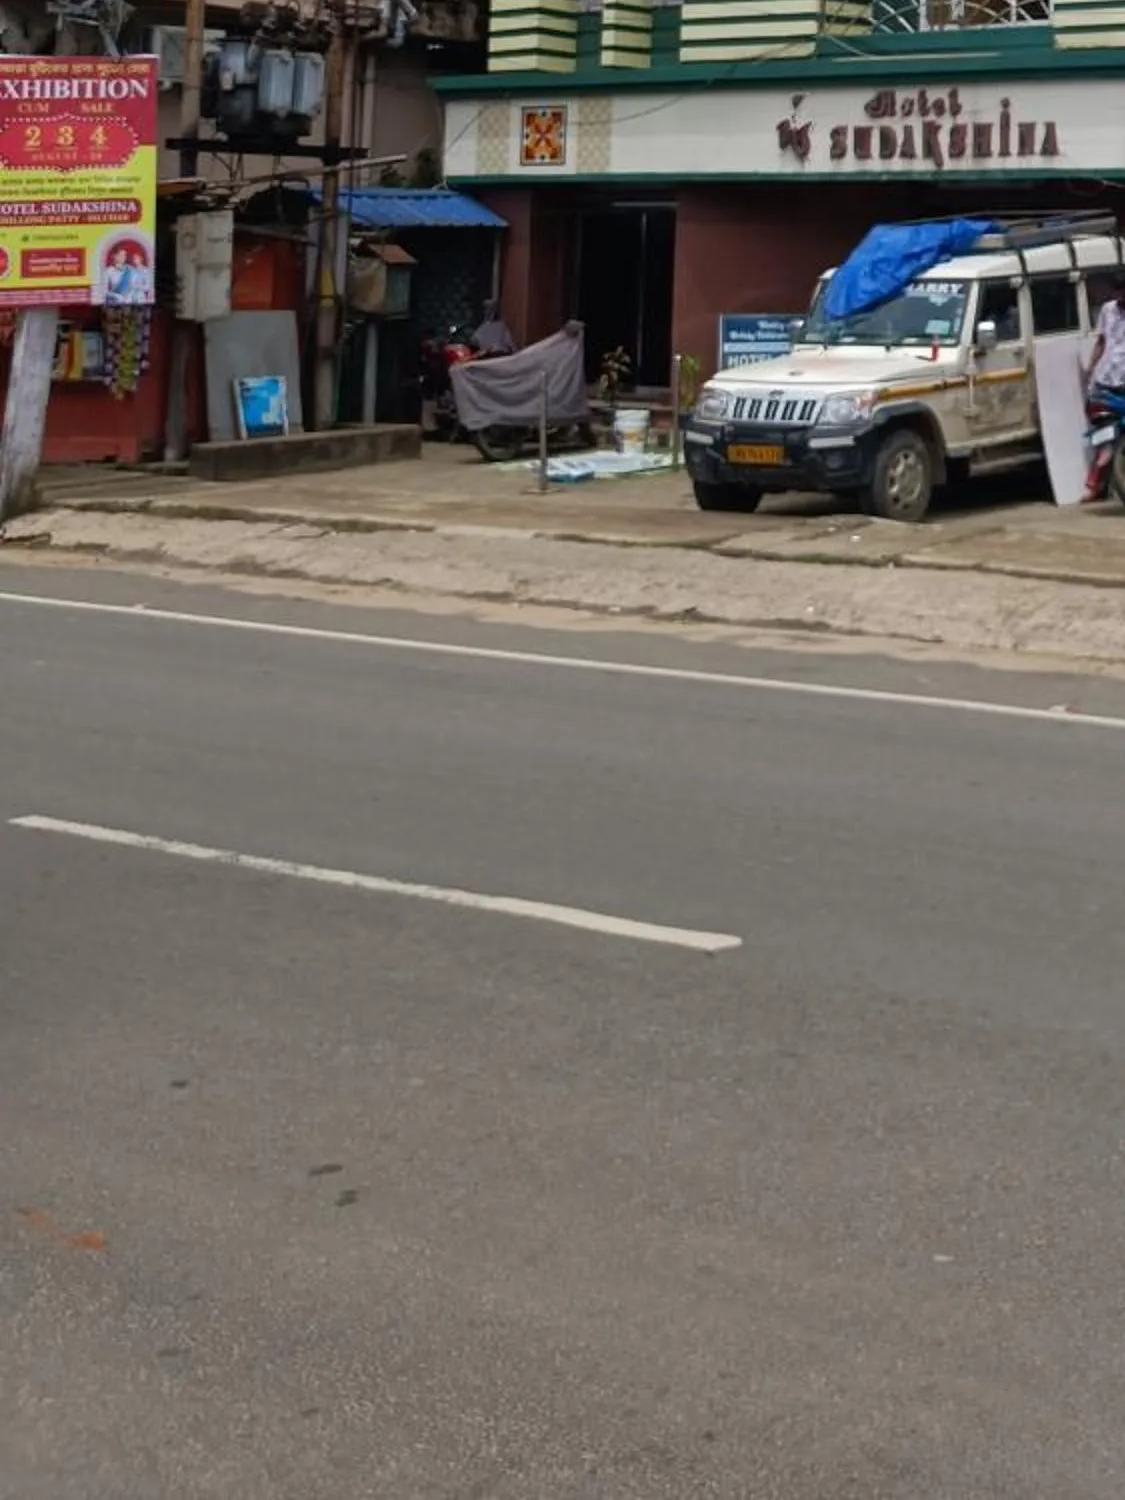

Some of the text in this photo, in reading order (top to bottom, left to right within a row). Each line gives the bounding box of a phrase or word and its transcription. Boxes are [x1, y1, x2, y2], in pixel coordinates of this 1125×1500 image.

[0, 78, 148, 100] XHIBITION
[864, 88, 962, 118] Hotel
[25, 125, 107, 147] 2 3 4
[0, 203, 38, 215] OTEL
